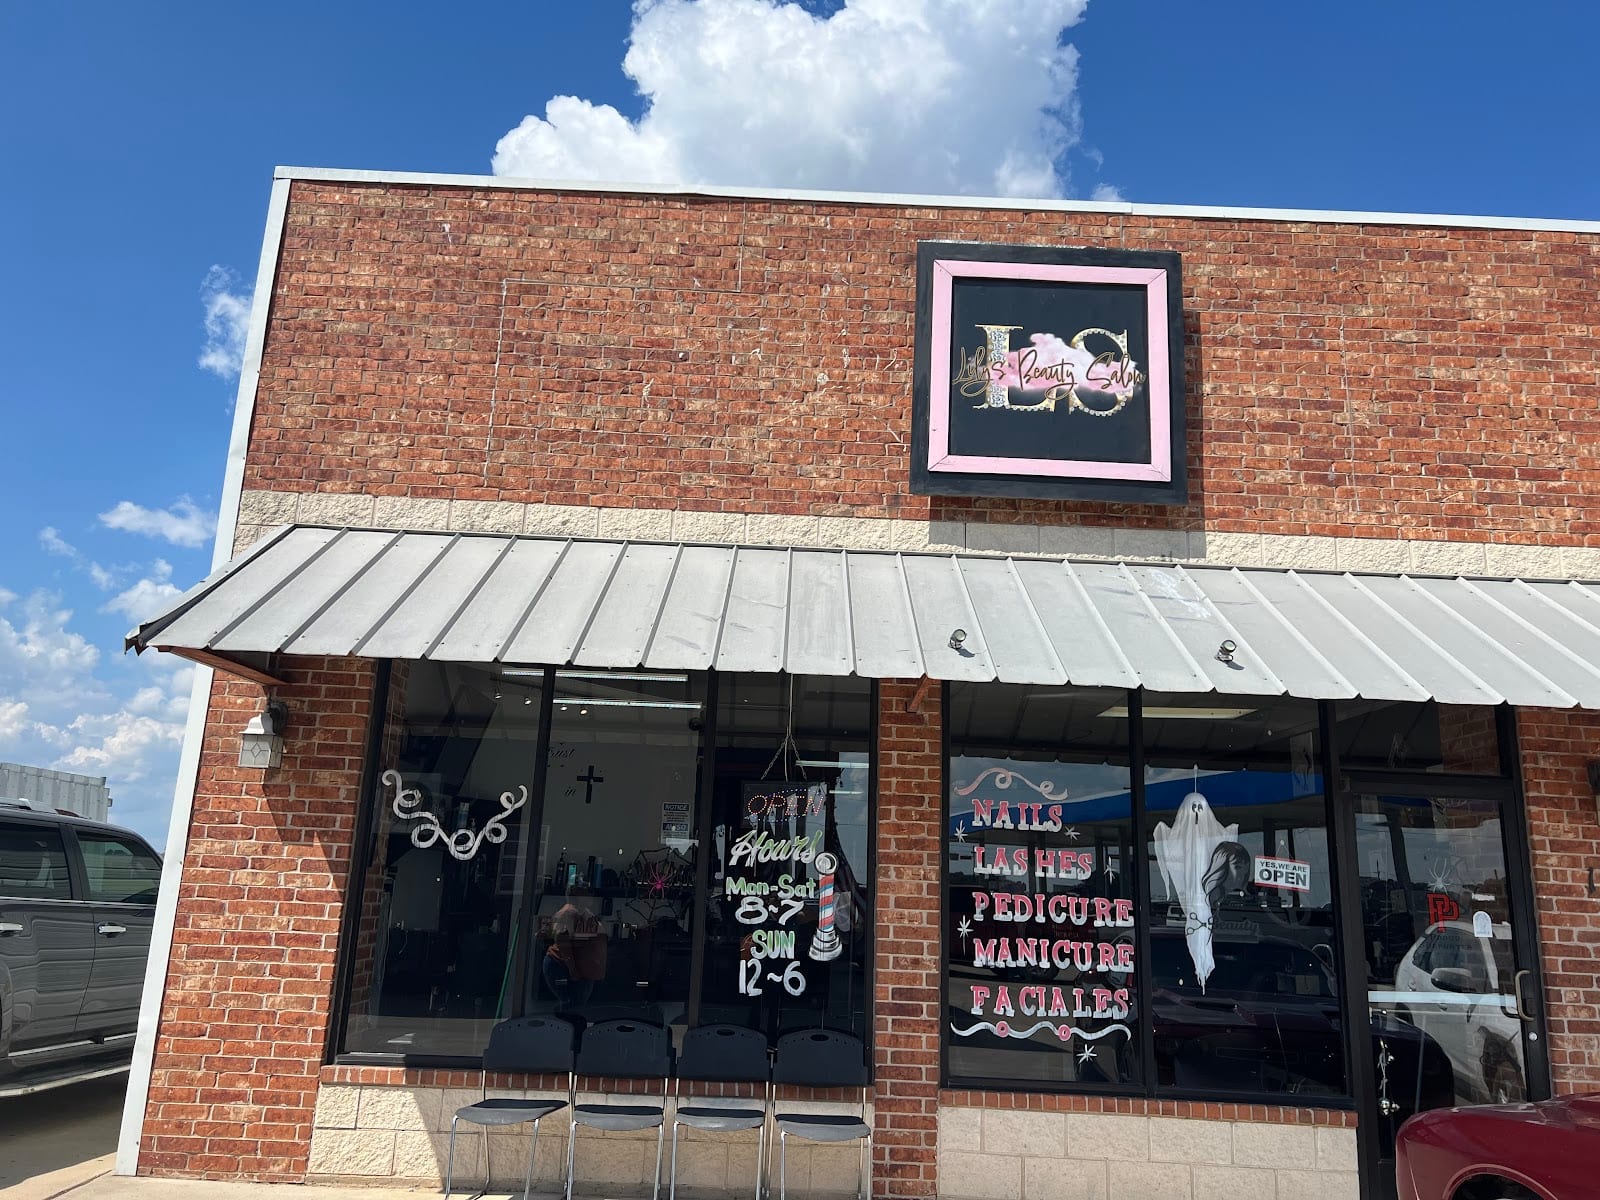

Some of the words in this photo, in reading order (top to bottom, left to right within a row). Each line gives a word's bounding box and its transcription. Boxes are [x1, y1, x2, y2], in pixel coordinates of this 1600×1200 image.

[1017, 349, 1078, 400] Beauty
[1086, 351, 1146, 389] Salon
[748, 794, 824, 817] OPEN
[971, 799, 1063, 833] NAILS
[728, 829, 823, 868] Hours
[973, 847, 1093, 880] LASHES
[725, 873, 817, 900] Mon-Sat
[1259, 868, 1307, 887] OPEN
[972, 892, 1135, 927] PEDICURE
[750, 929, 796, 960] SUN
[973, 938, 1135, 973] MANICURE
[970, 985, 1129, 1020] FACIALES
